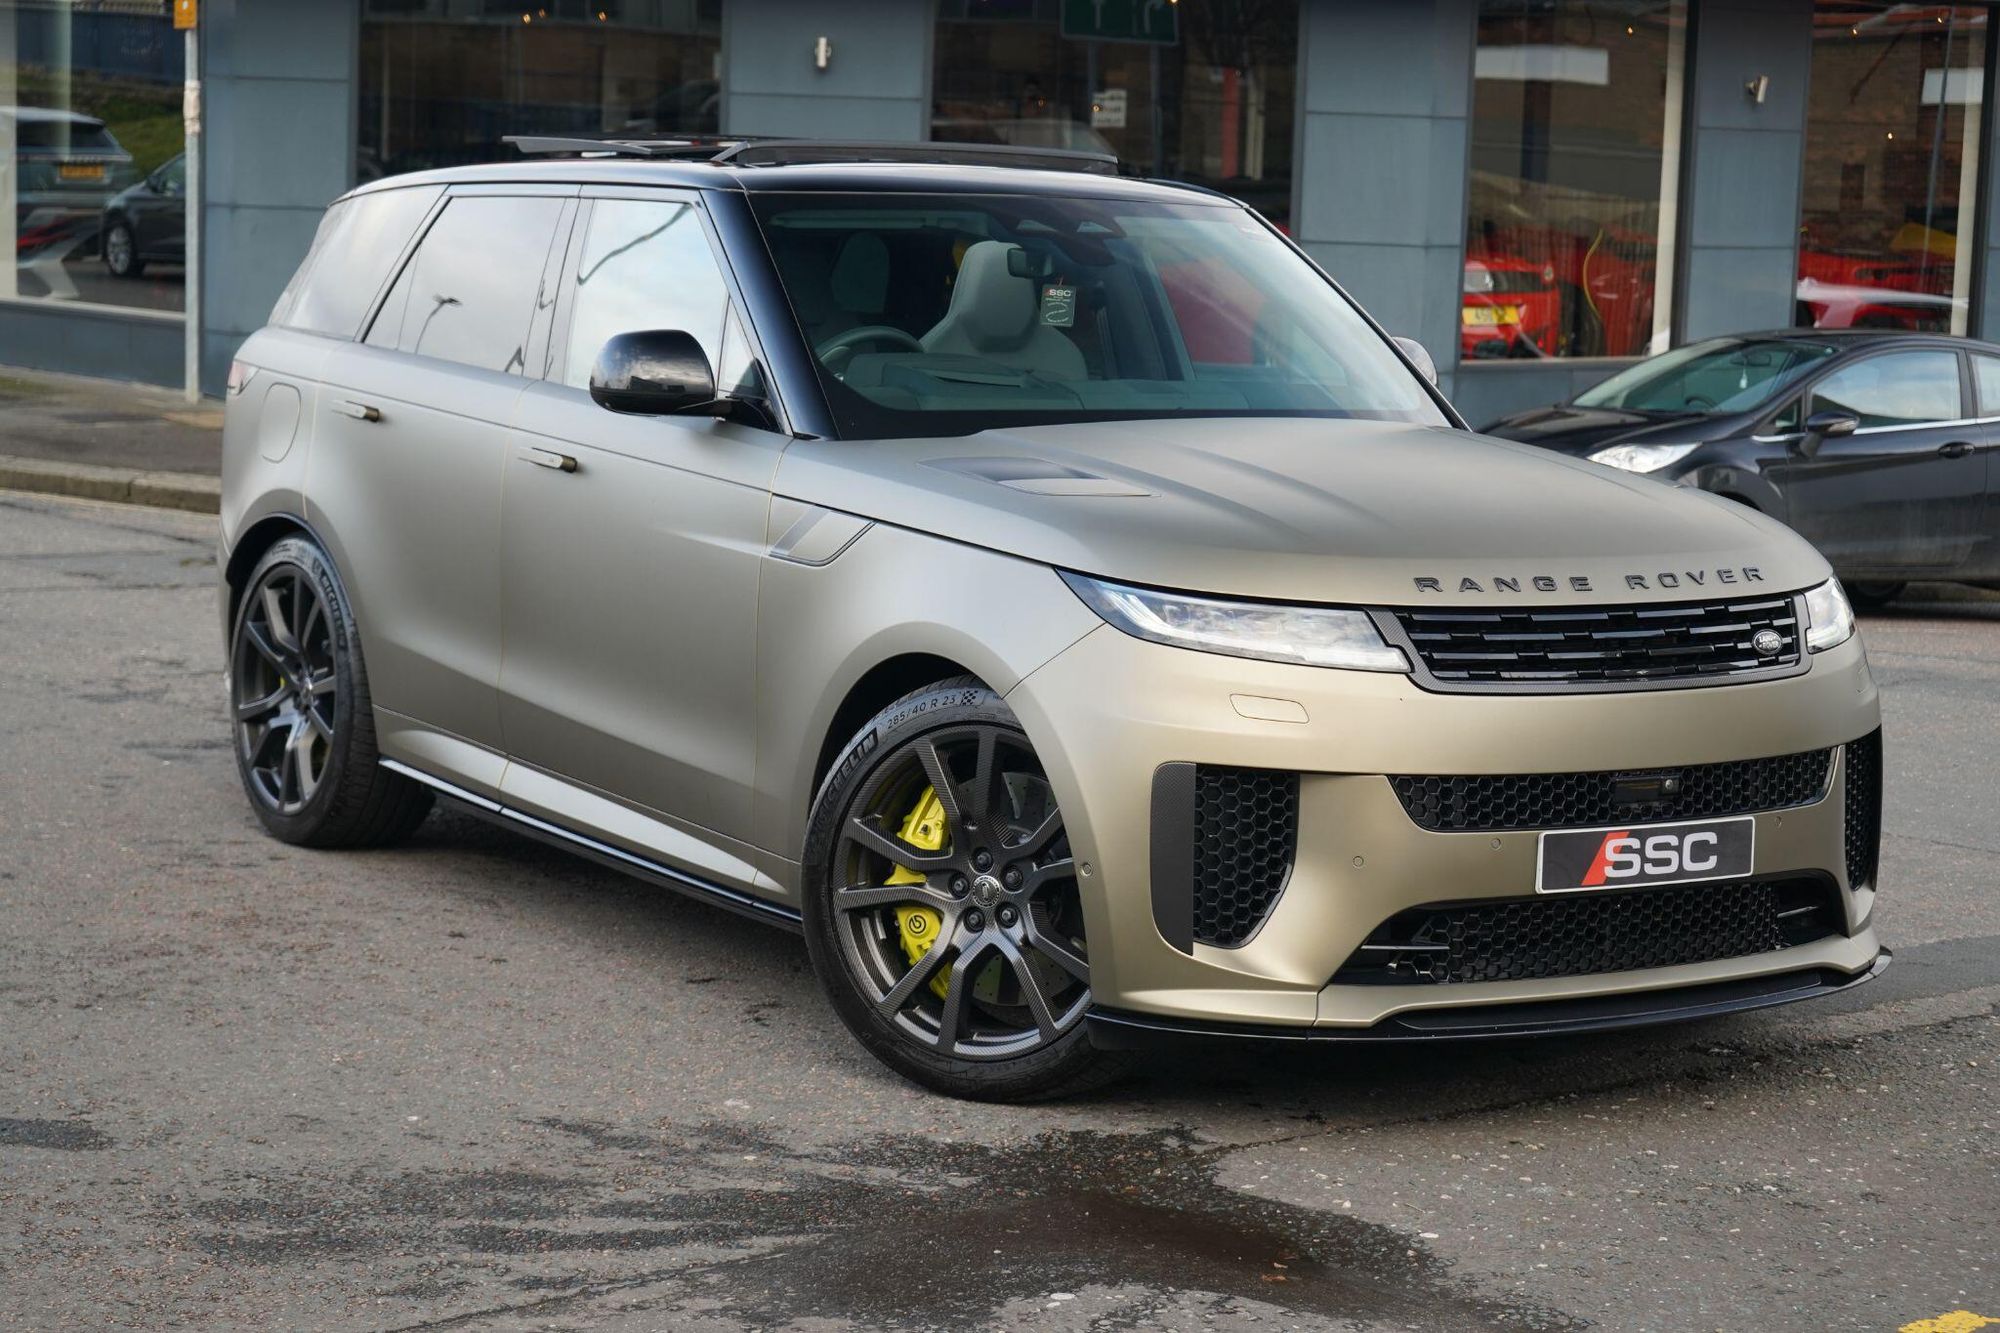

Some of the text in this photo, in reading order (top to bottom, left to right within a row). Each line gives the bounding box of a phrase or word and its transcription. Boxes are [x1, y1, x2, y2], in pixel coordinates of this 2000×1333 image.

[1049, 288, 1071, 297] SSC
[1413, 565, 1765, 593] RANGE ROVER
[887, 694, 956, 729] 285/40 R 23
[1603, 831, 1718, 878] SSC
